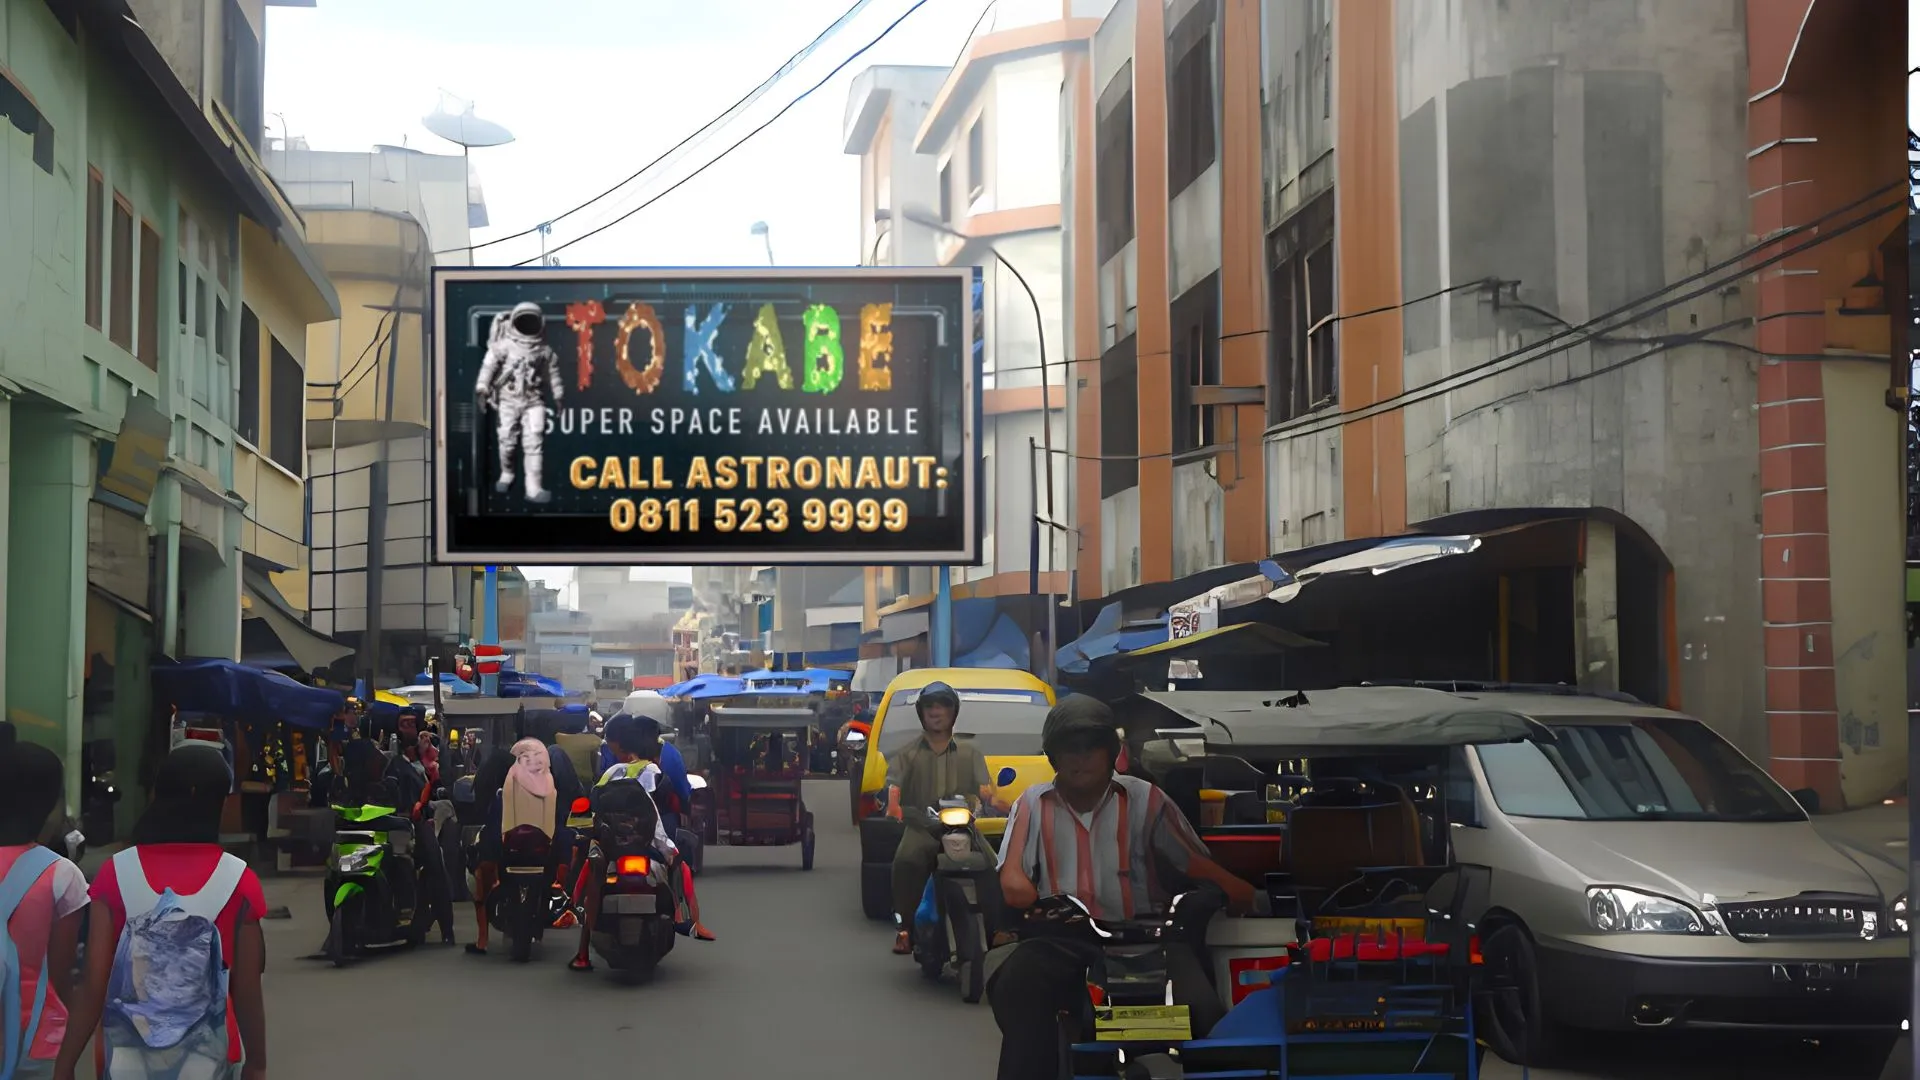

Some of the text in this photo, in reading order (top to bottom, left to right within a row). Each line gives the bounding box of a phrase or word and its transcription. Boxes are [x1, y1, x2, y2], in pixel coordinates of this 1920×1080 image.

[565, 300, 893, 394] TOKABE
[651, 407, 742, 434] SPACE
[758, 407, 919, 434] AVAILABLE
[569, 455, 949, 490] CALL ASTRONAUT:
[609, 498, 909, 533] 0811 523 9999
